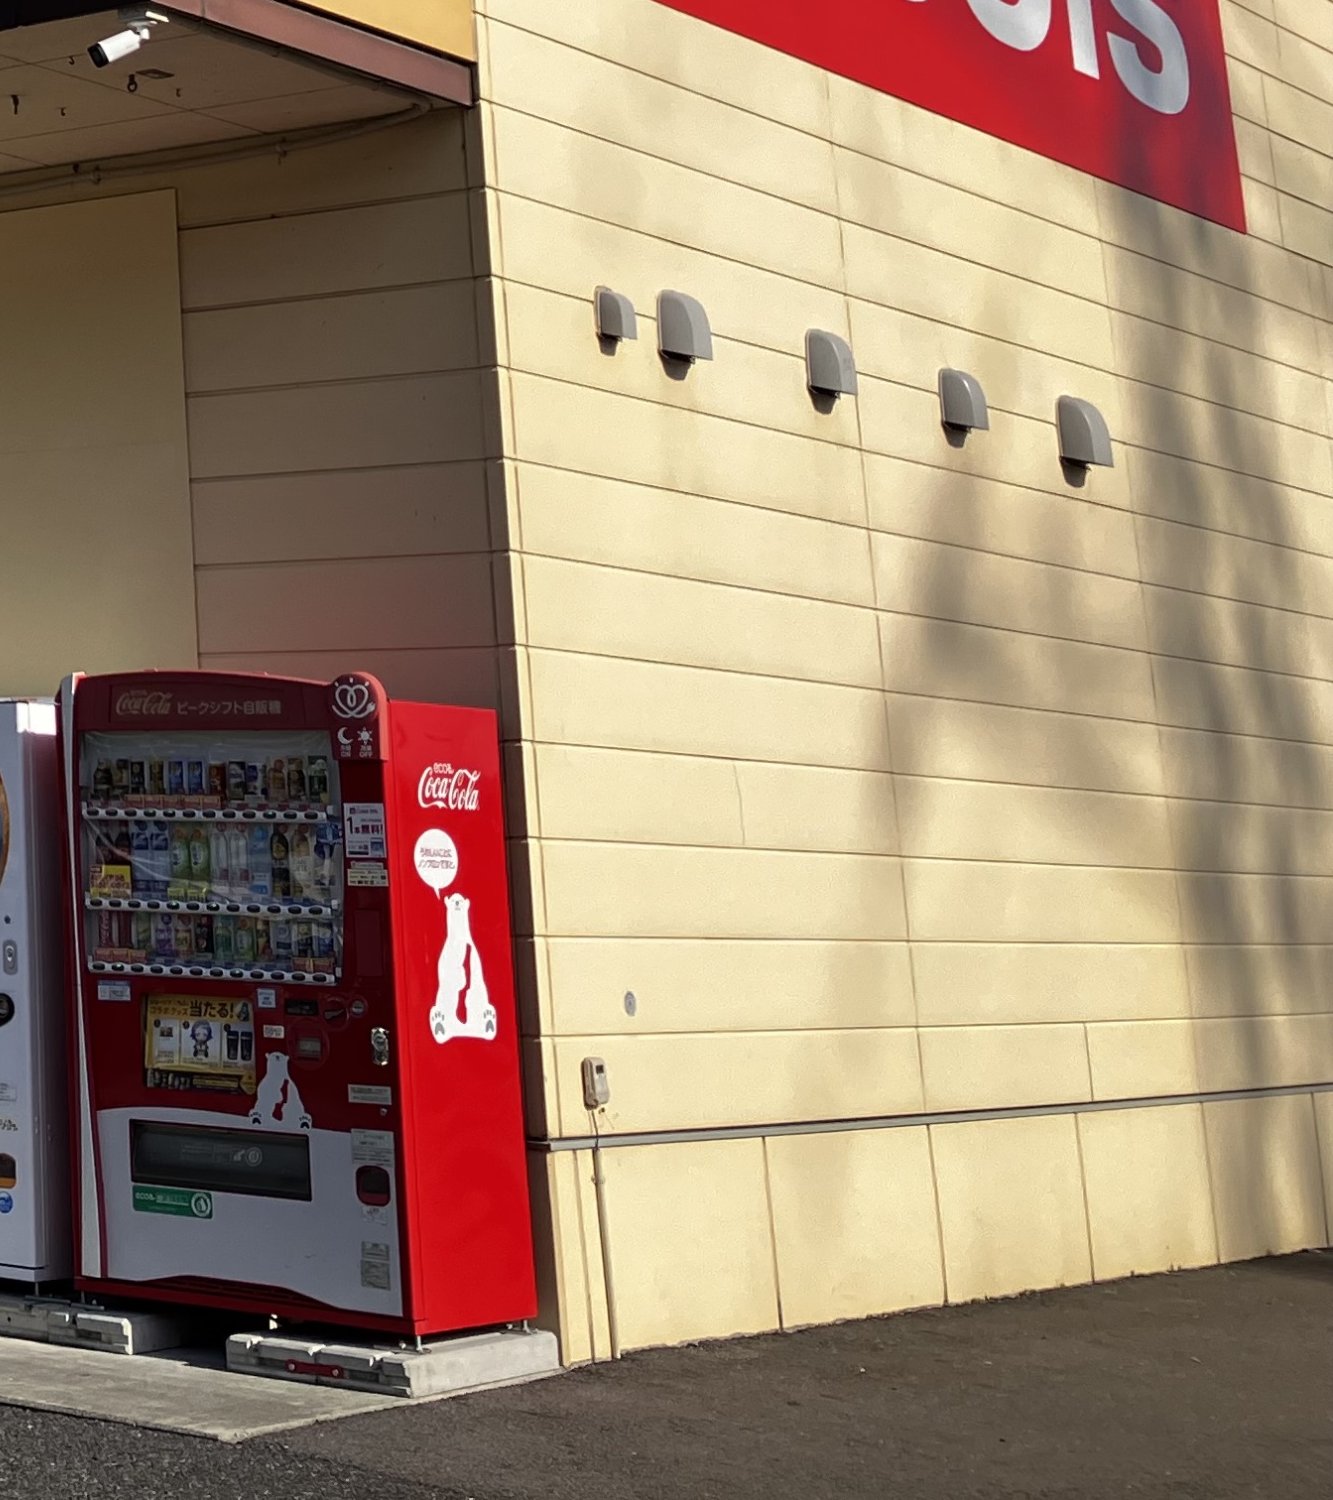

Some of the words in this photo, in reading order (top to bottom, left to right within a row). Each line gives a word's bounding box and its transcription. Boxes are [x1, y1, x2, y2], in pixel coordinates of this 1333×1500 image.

[176, 699, 282, 715] ピークシフト自販機
[417, 766, 481, 811] Coca-Cola
